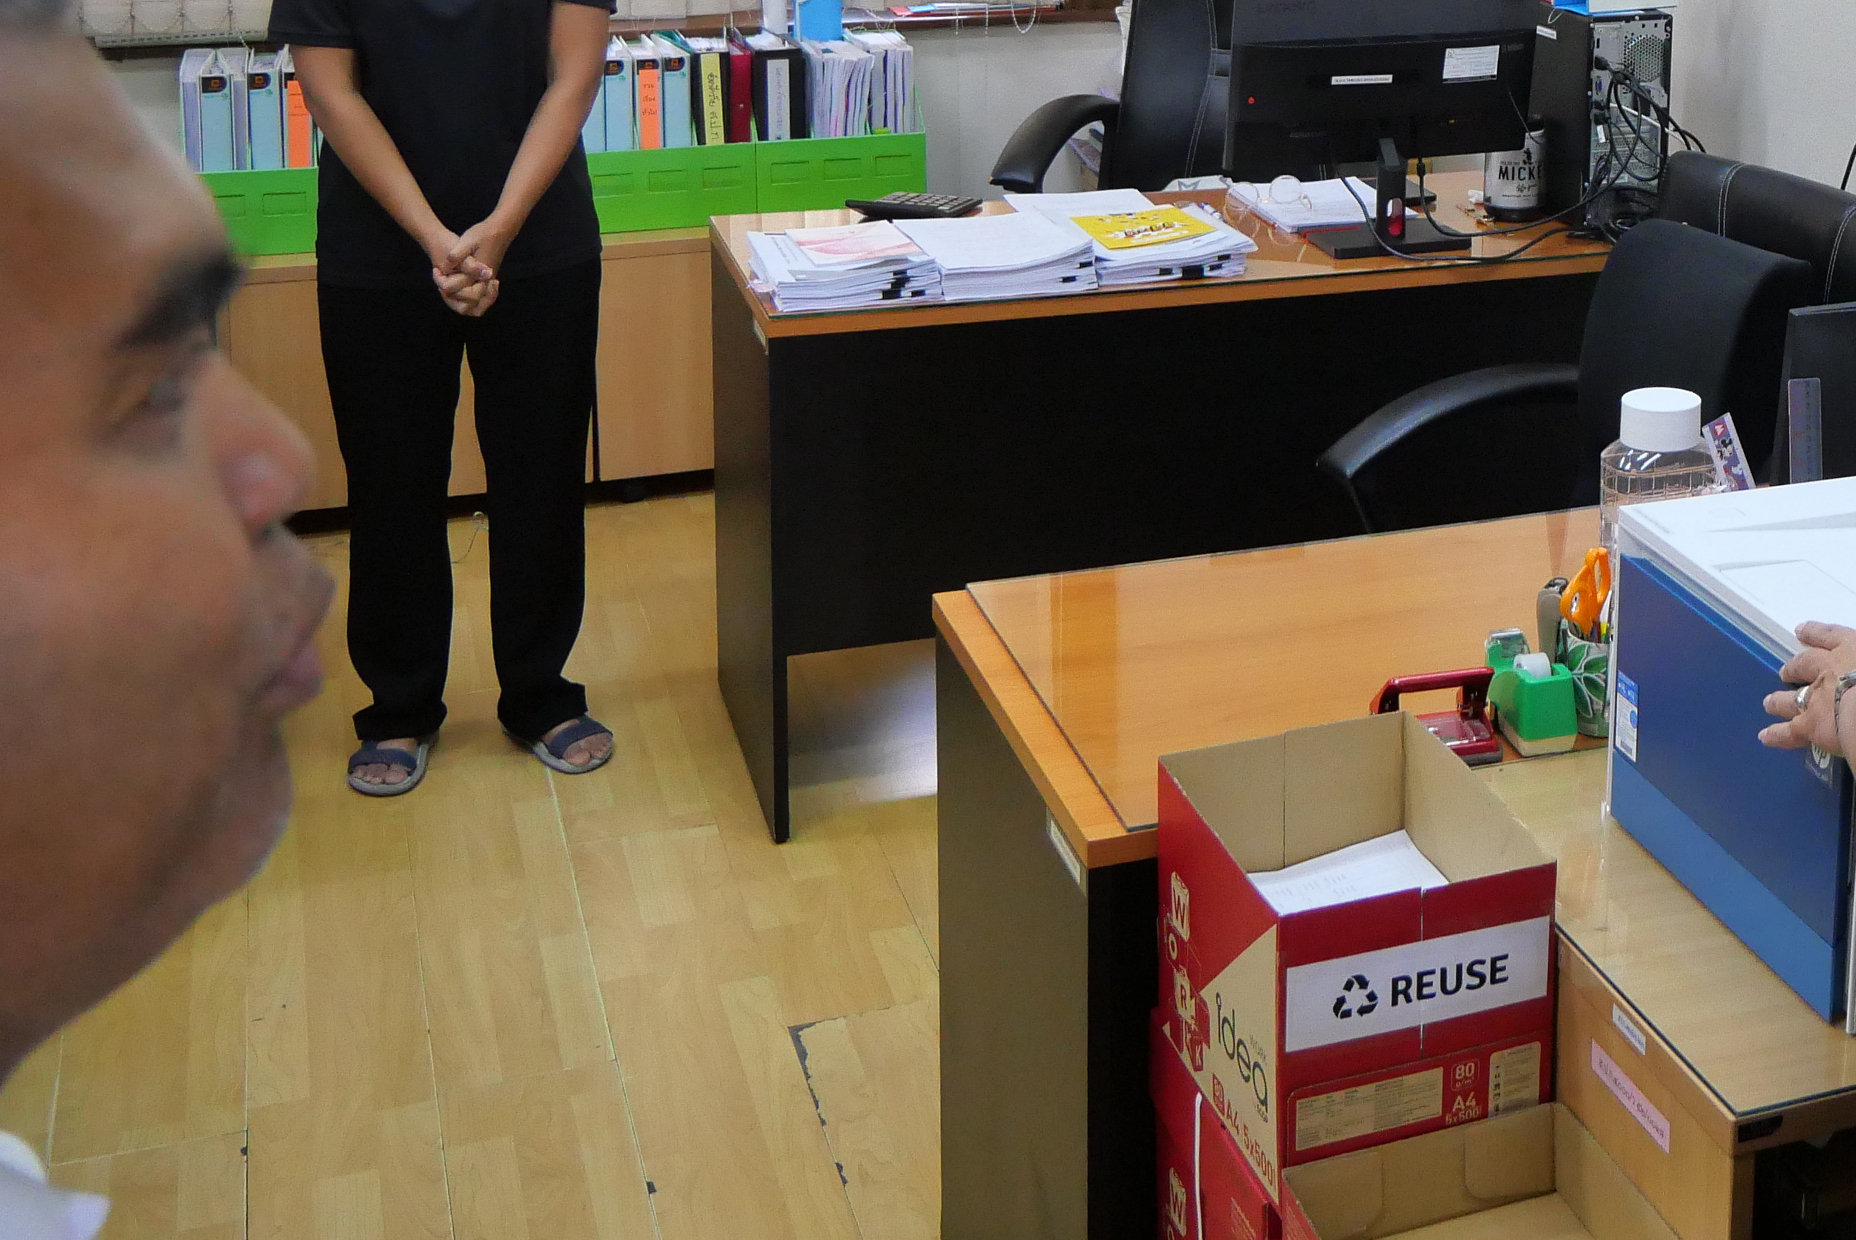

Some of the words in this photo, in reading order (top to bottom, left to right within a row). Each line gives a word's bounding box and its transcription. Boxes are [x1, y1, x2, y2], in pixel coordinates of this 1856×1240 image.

[1391, 954, 1509, 1008] REUSE
[1216, 992, 1268, 1113] idea
[1456, 1062, 1475, 1080] 80
[1227, 1099, 1239, 1135] A4
[1452, 1092, 1476, 1112] A4
